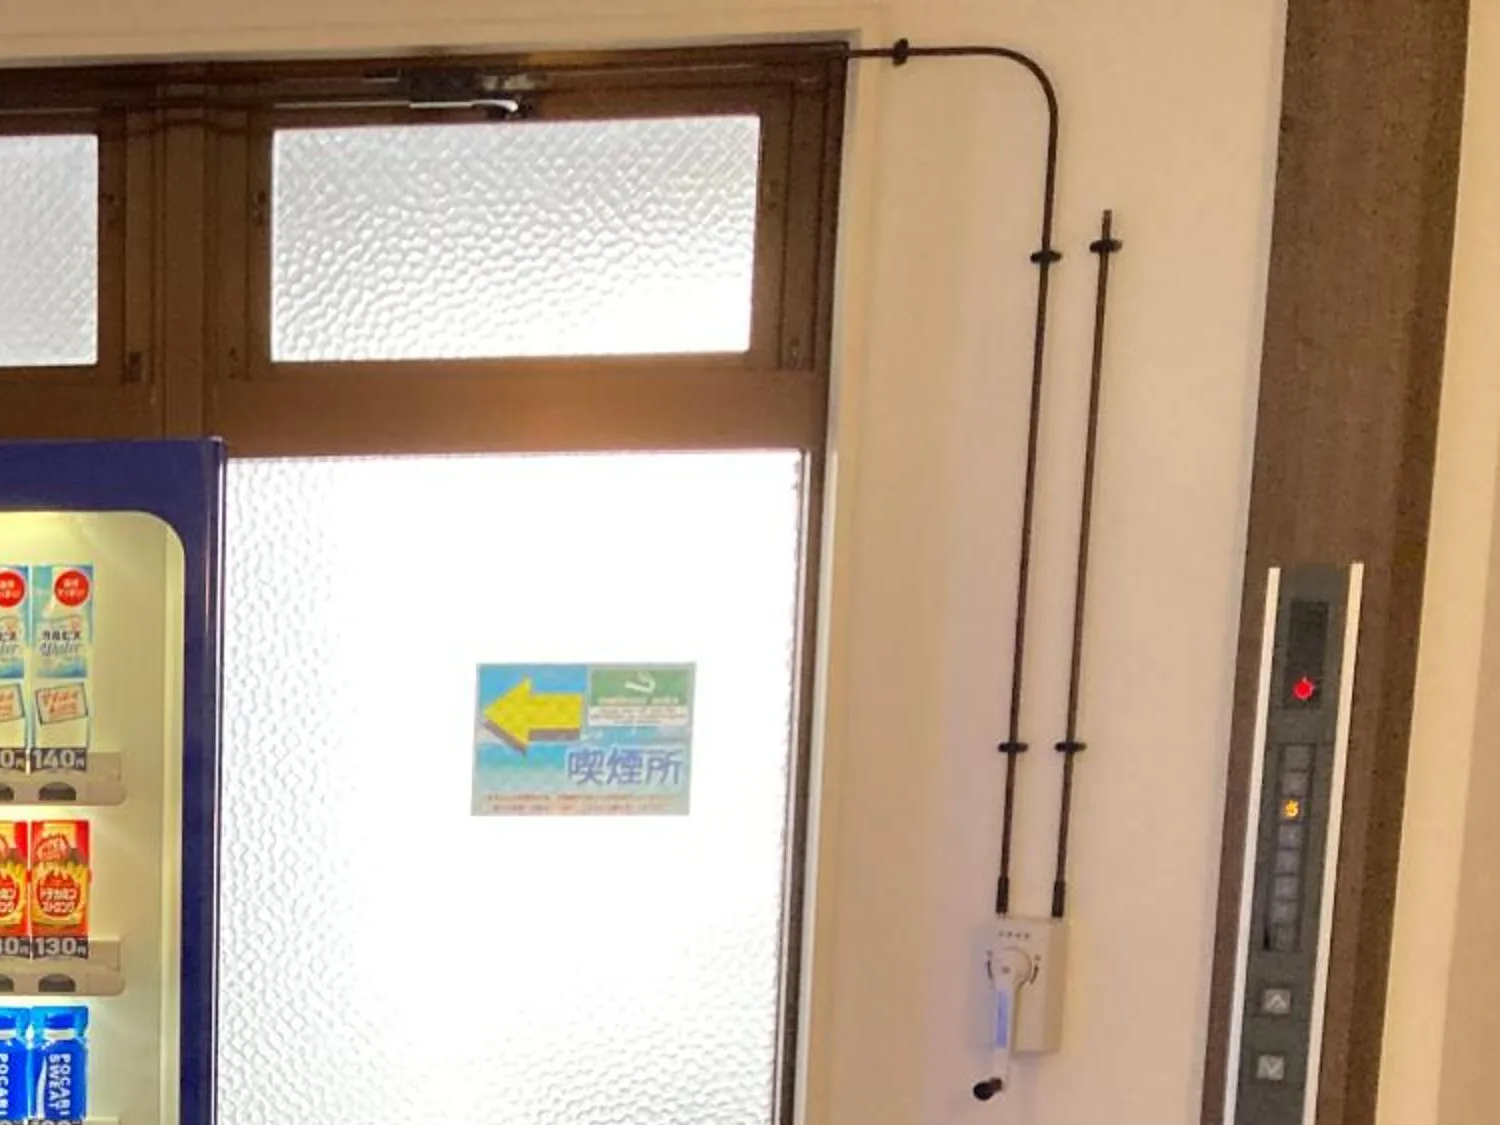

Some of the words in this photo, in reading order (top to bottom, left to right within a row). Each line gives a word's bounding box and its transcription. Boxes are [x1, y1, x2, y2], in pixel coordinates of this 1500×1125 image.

[567, 748, 684, 786] 喫煙所
[47, 1053, 60, 1109] SWEAT
[58, 1053, 72, 1116] POCARI
